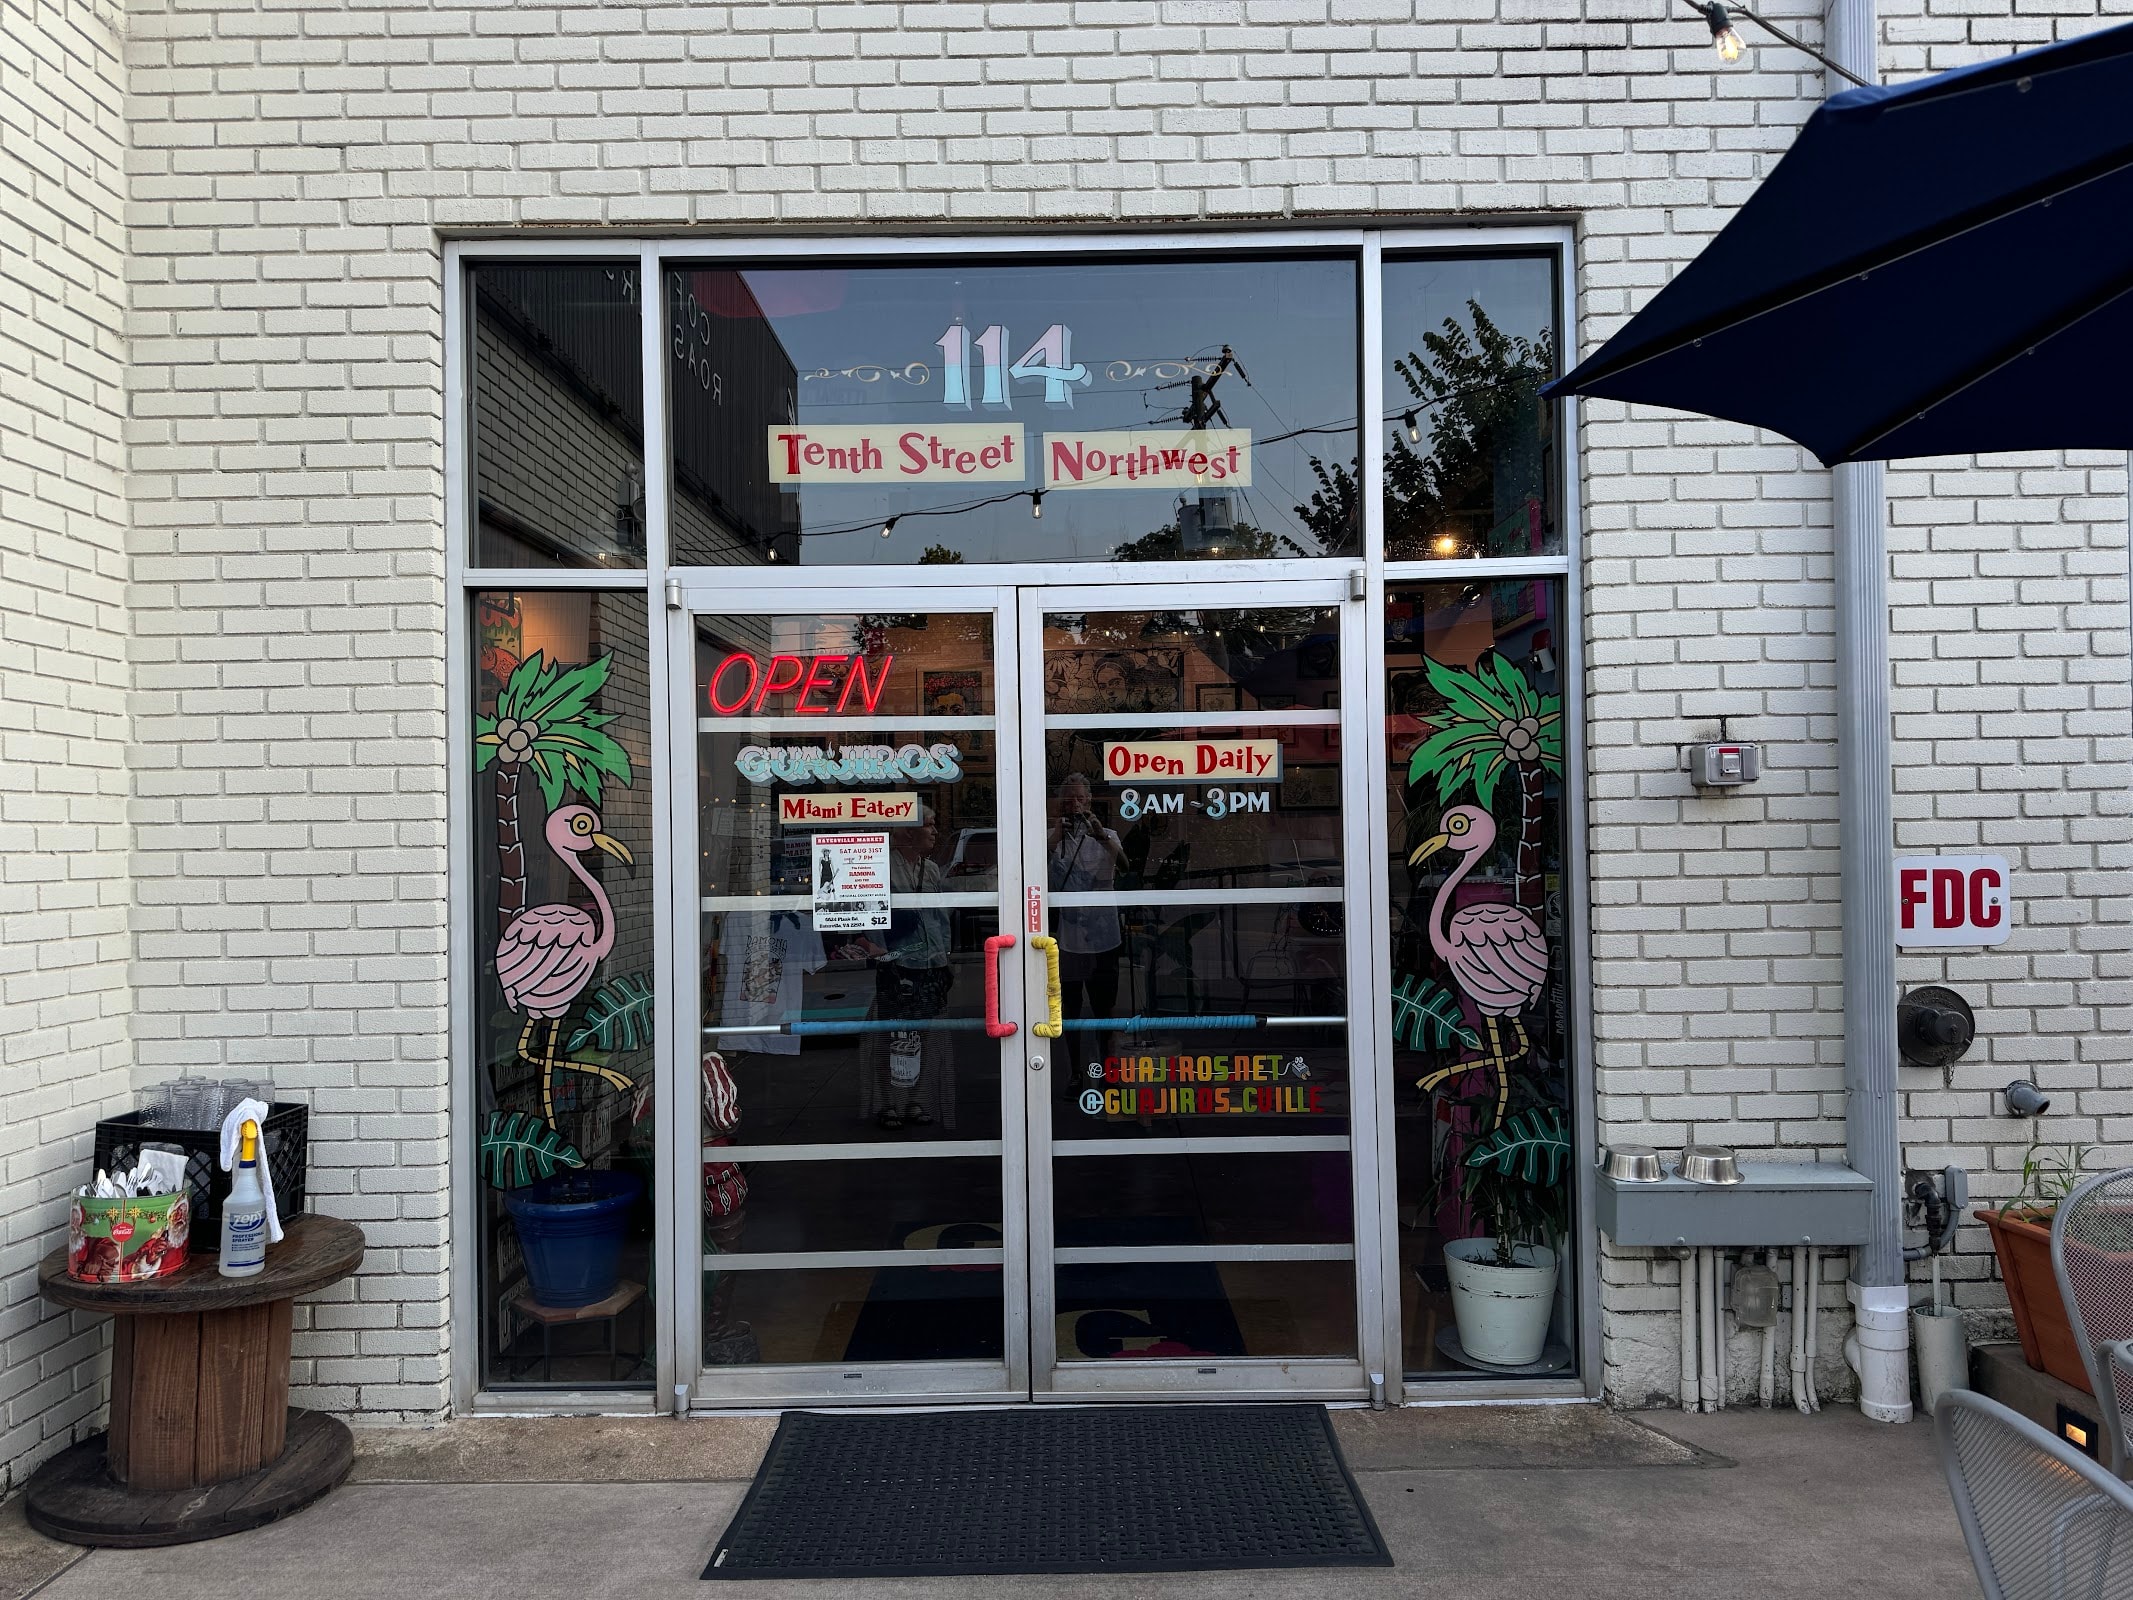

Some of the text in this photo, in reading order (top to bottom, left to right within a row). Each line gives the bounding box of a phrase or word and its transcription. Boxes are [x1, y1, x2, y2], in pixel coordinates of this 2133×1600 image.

[934, 323, 1093, 411] 114
[777, 432, 1015, 475] Tenth Street
[1053, 440, 1242, 482] Northwest
[709, 653, 893, 714] OPEN
[734, 742, 964, 786] GUAJIROS
[1107, 744, 1273, 776] Open Daily
[782, 797, 915, 820] Miami Eatery
[1119, 788, 1185, 821] 8AM
[1206, 788, 1271, 821] 3PM
[1900, 868, 2002, 929] FDC
[871, 916, 887, 926] $12
